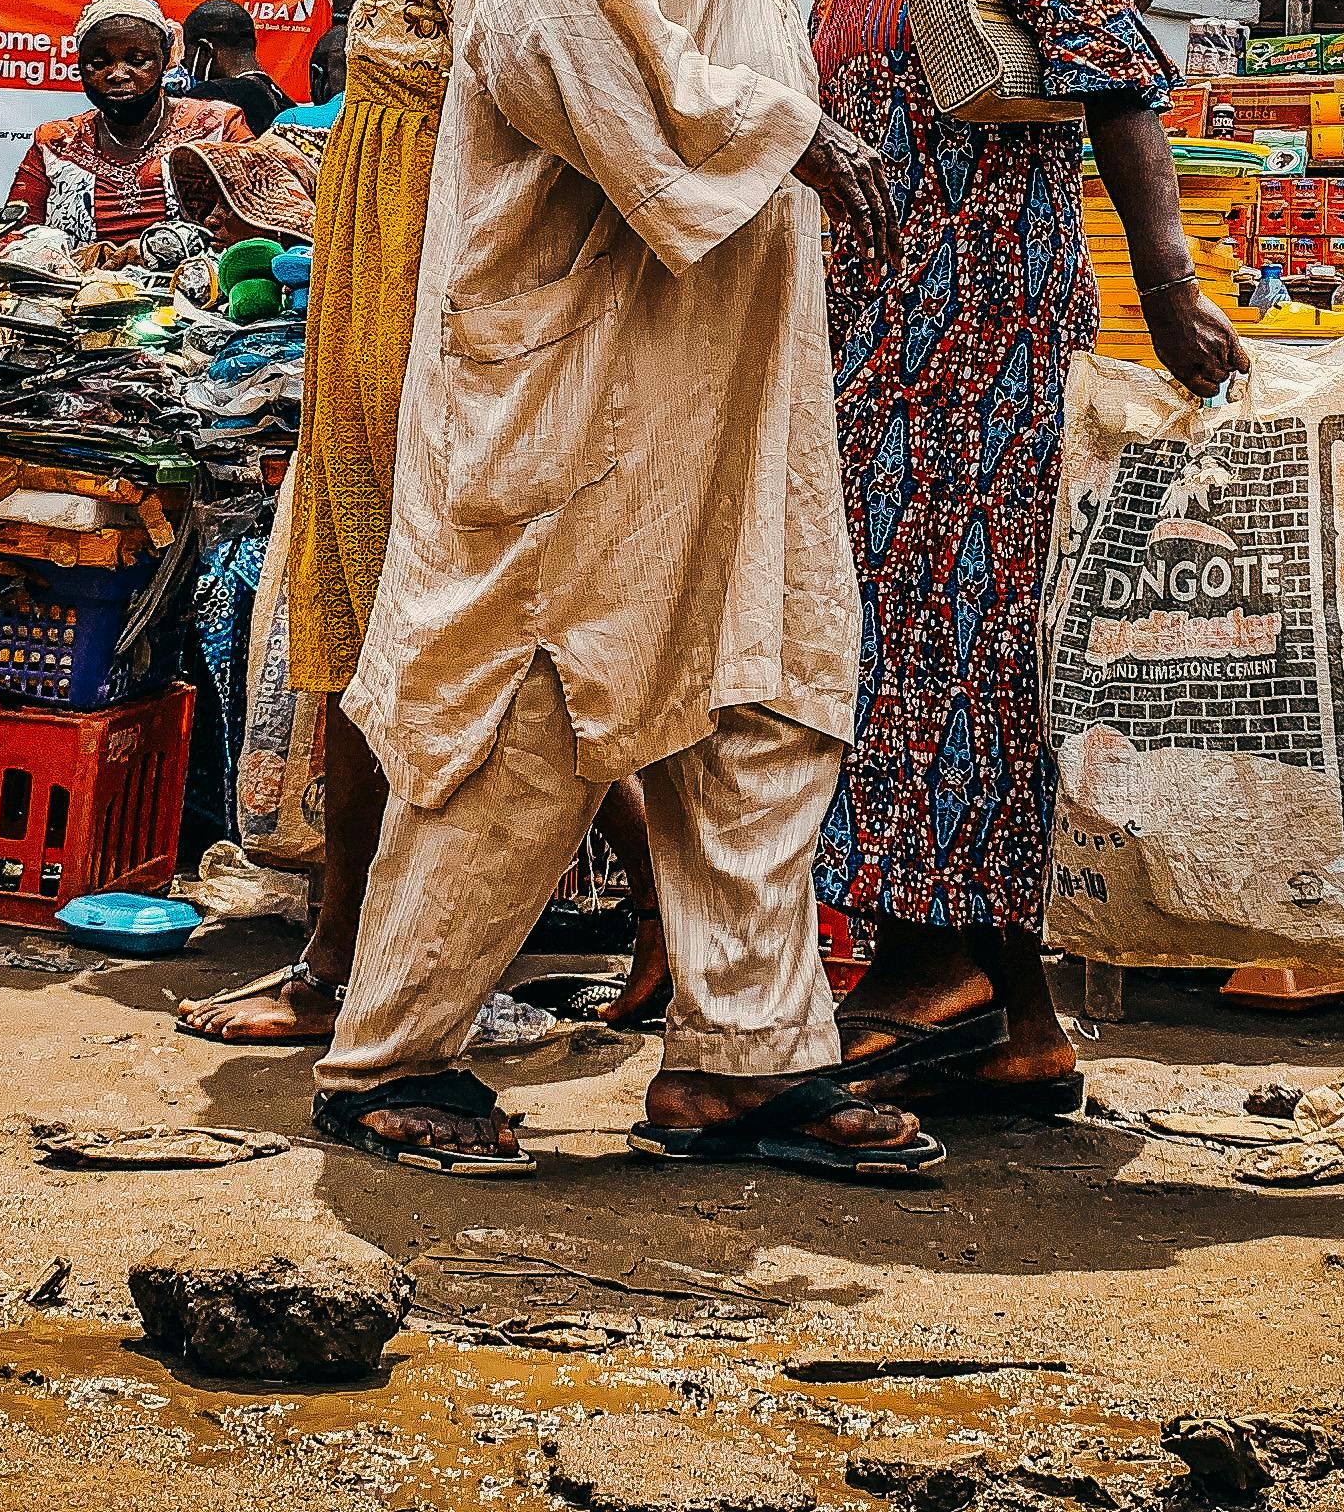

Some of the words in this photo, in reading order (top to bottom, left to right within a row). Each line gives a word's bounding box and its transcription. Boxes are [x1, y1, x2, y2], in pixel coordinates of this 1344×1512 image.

[243, 1, 289, 21] UBA
[11, 131, 33, 144] your
[1103, 554, 1284, 609] DNGOTE
[1083, 663, 1138, 686] POND
[1142, 661, 1222, 681] LIMESTONE
[1226, 658, 1277, 678] CEMENT
